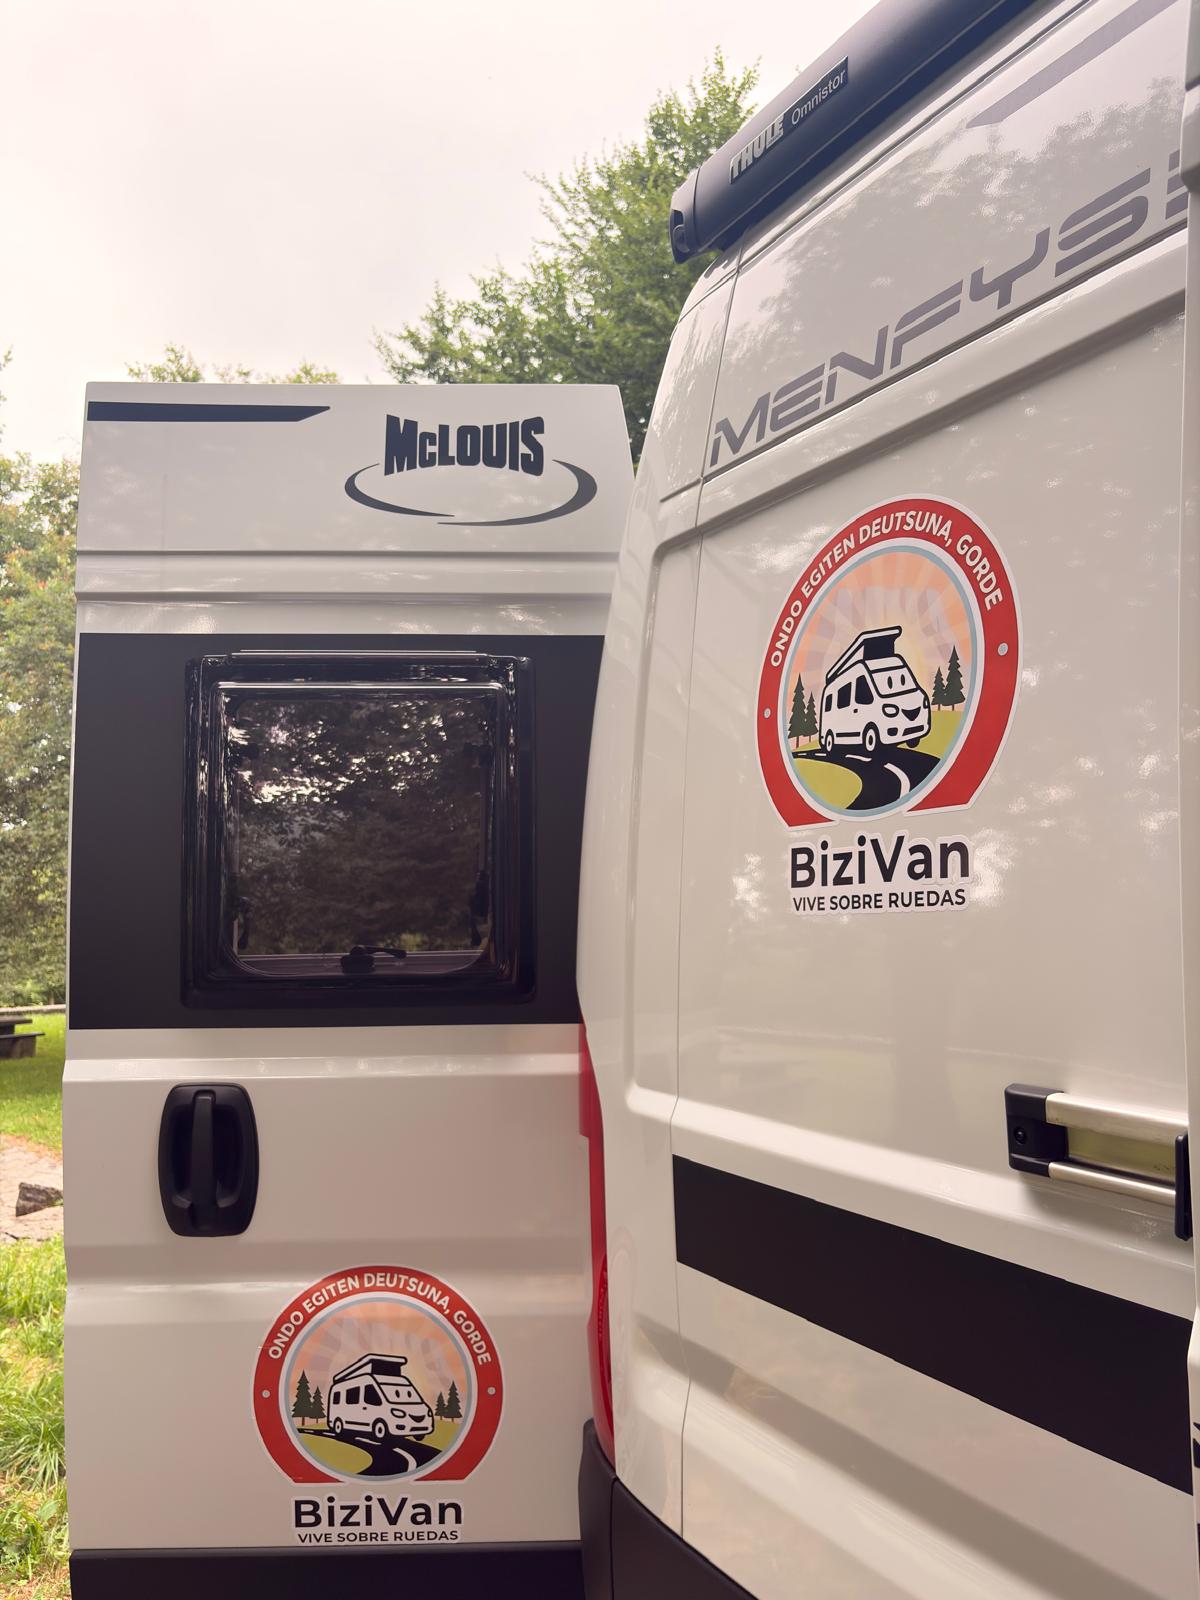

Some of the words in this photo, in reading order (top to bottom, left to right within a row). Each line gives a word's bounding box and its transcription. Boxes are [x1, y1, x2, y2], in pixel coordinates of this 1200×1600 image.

[729, 112, 785, 182] THULE
[791, 69, 846, 125] Omnistor
[709, 149, 1188, 467] MENFYS
[770, 599, 803, 667] ONDO
[801, 533, 855, 599] EGITEN
[858, 510, 953, 548] DEUTSUNA,
[956, 534, 1004, 611] GORDE
[790, 834, 970, 889] BiziVan
[793, 896, 826, 912] VIVE
[829, 893, 884, 911] SOBRE
[888, 888, 966, 909] RUEDAS
[268, 1310, 305, 1360] ONDO
[303, 1273, 361, 1314] EGITEN
[363, 1272, 451, 1316] DEUTSUNA,
[452, 1310, 492, 1366] GORDE
[294, 1494, 463, 1529] BiziVan
[297, 1532, 333, 1544] VIVE
[336, 1531, 390, 1543] SOBRE
[393, 1530, 460, 1541] RUEDAS
